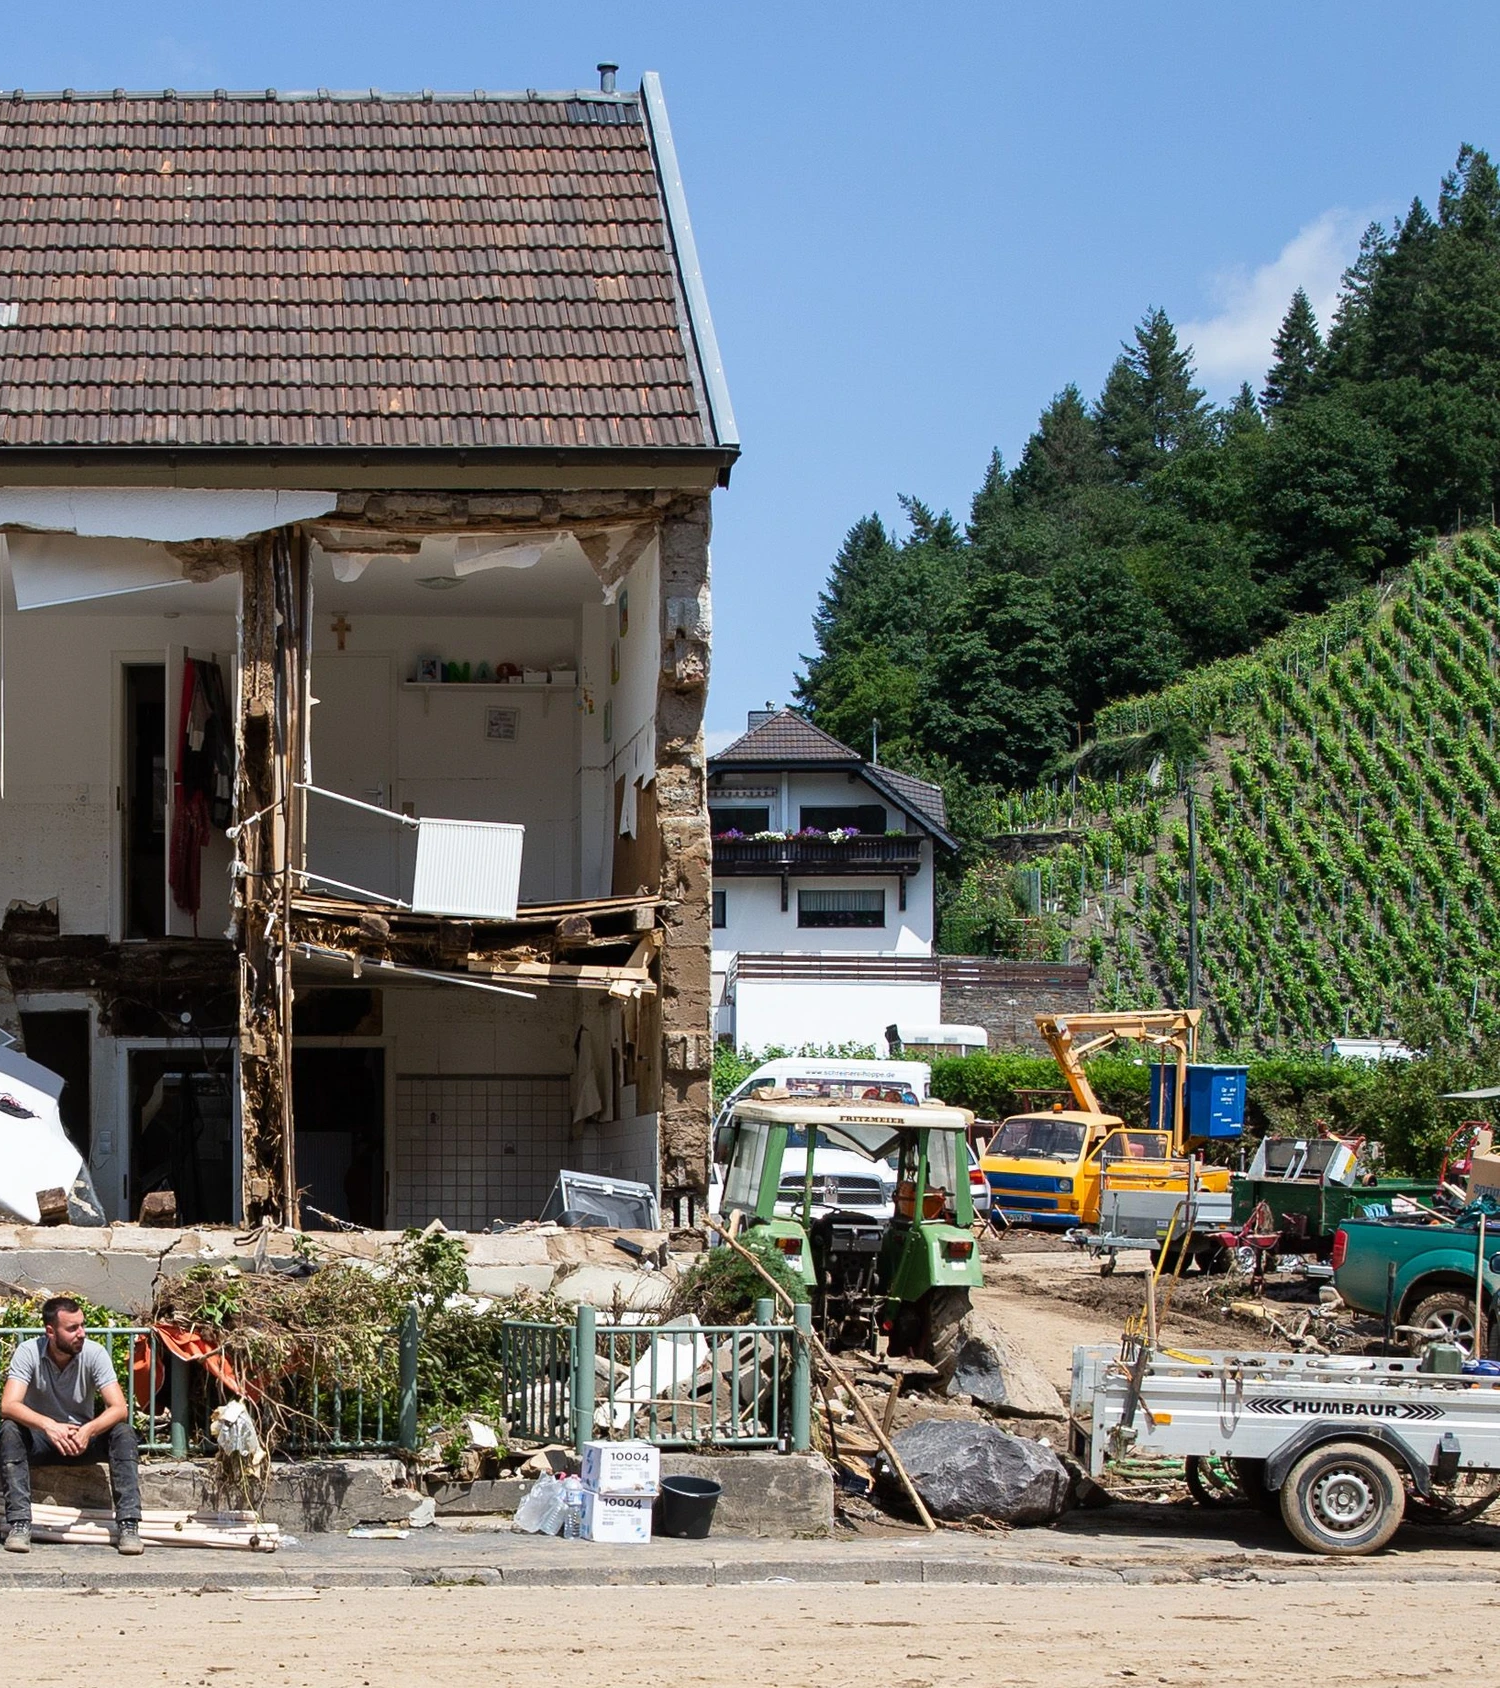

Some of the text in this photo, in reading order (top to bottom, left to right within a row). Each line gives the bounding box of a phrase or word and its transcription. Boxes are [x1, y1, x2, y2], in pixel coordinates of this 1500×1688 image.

[839, 1115, 905, 1124] FRITZMEIER
[1292, 1401, 1399, 1417] HUMBAUR
[610, 1452, 650, 1463] 10004
[603, 1498, 643, 1510] 10004
